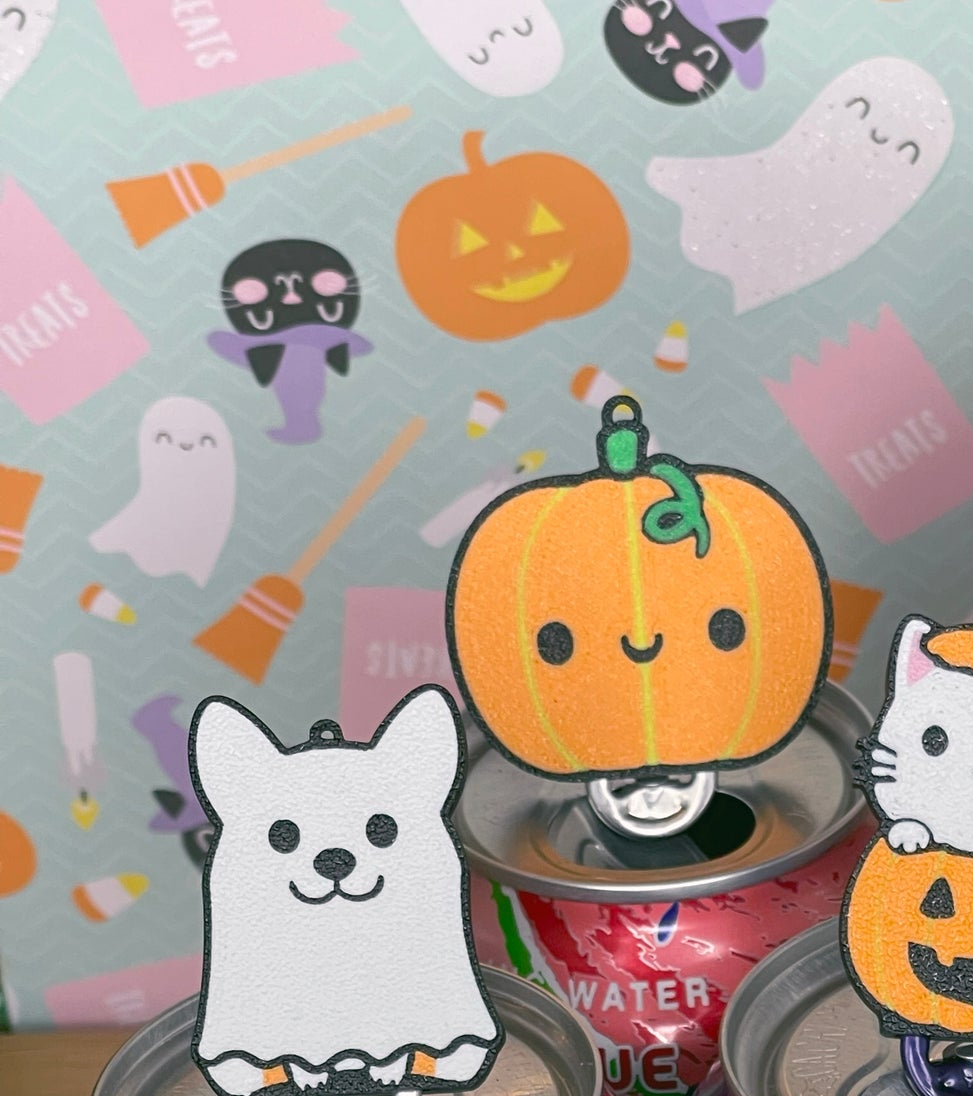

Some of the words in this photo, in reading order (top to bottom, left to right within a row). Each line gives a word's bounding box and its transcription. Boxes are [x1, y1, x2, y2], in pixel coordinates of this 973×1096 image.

[170, 0, 239, 69] EATS
[849, 410, 947, 487] TREATS
[568, 977, 710, 1012] WATER
[599, 1045, 680, 1092] UE
